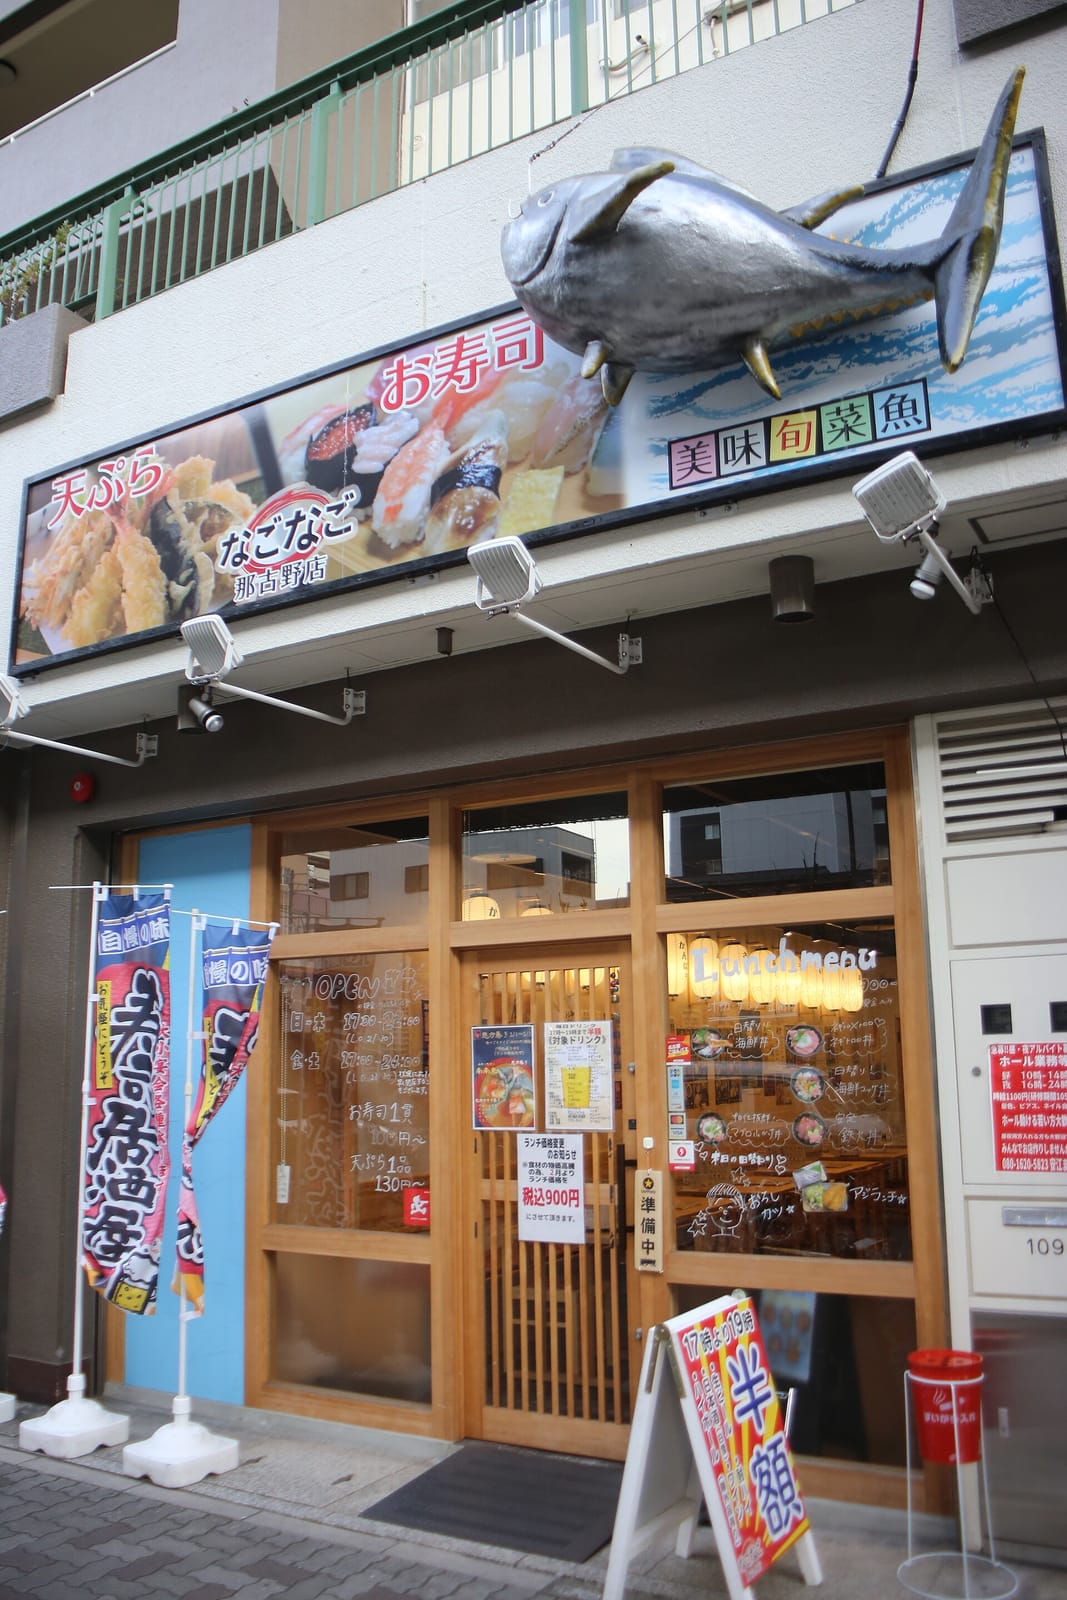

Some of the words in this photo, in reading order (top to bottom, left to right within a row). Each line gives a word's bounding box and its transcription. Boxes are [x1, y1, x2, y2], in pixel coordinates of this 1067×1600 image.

[381, 315, 545, 413] お寿司
[675, 391, 923, 483] 美味旬菜魚
[48, 445, 163, 529] 天ぷら
[219, 491, 356, 569] なごなご
[233, 556, 328, 602] 那古野店
[100, 916, 170, 954] 自慢の味
[205, 956, 268, 984] 慢の味
[315, 973, 381, 1000] OPEN
[97, 983, 112, 1086] お気軽にどうぞ
[351, 1153, 412, 1175] 天ぷら1品
[524, 1137, 565, 1149] ランチ価格変更
[546, 1149, 577, 1161] のお知らせ
[522, 1186, 580, 1208] 税込900円
[640, 1196, 656, 1255] 準備中
[1026, 1238, 1064, 1255] 109
[684, 1310, 755, 1362] 17時より19時
[726, 1342, 804, 1541] 半額
